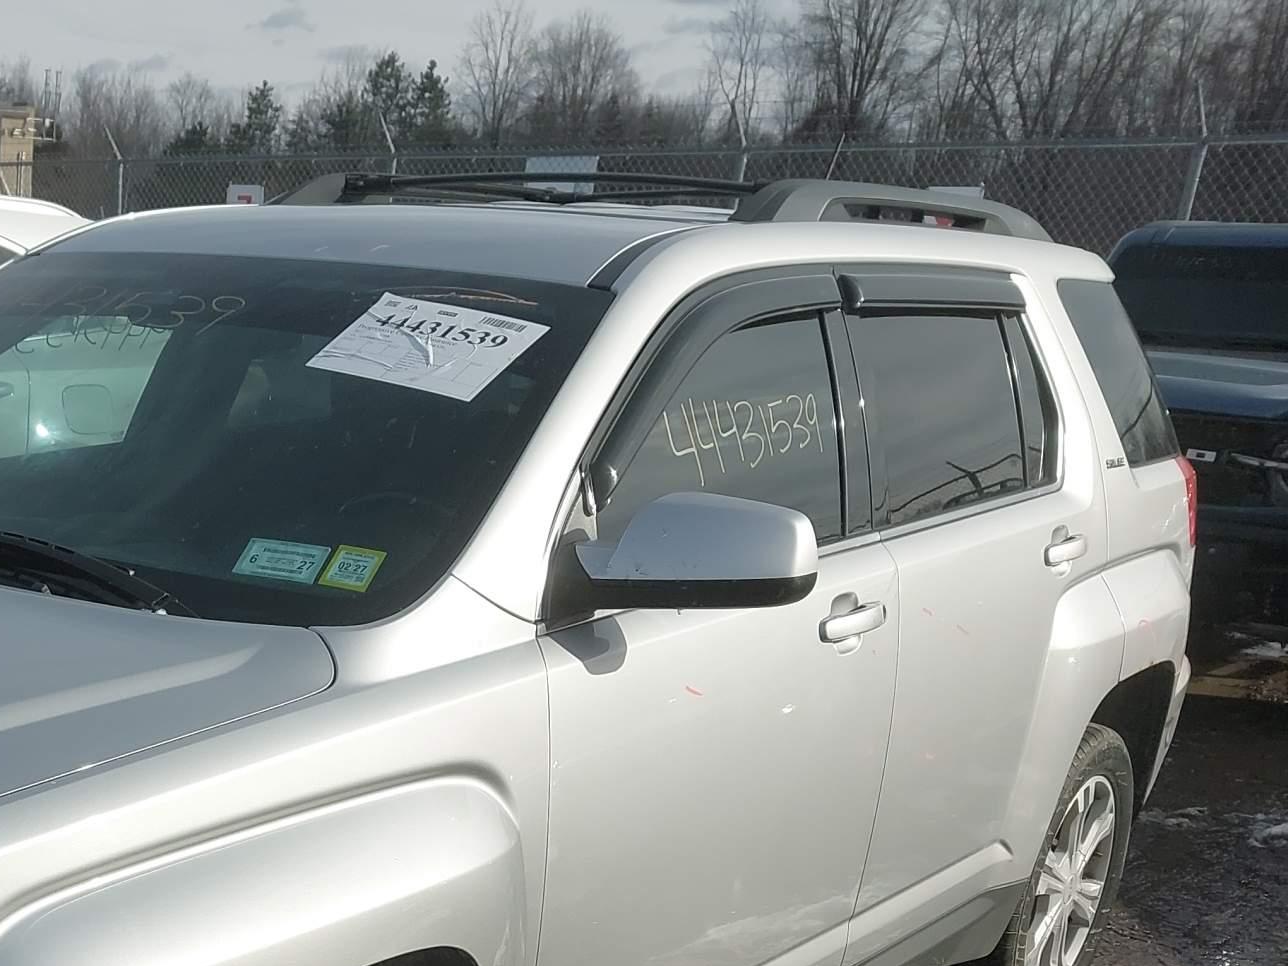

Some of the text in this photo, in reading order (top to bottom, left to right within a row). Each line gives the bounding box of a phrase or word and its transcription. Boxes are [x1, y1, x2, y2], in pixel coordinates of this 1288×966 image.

[376, 313, 509, 348] 44431539
[662, 392, 824, 488] 44431539
[296, 560, 315, 572] 27
